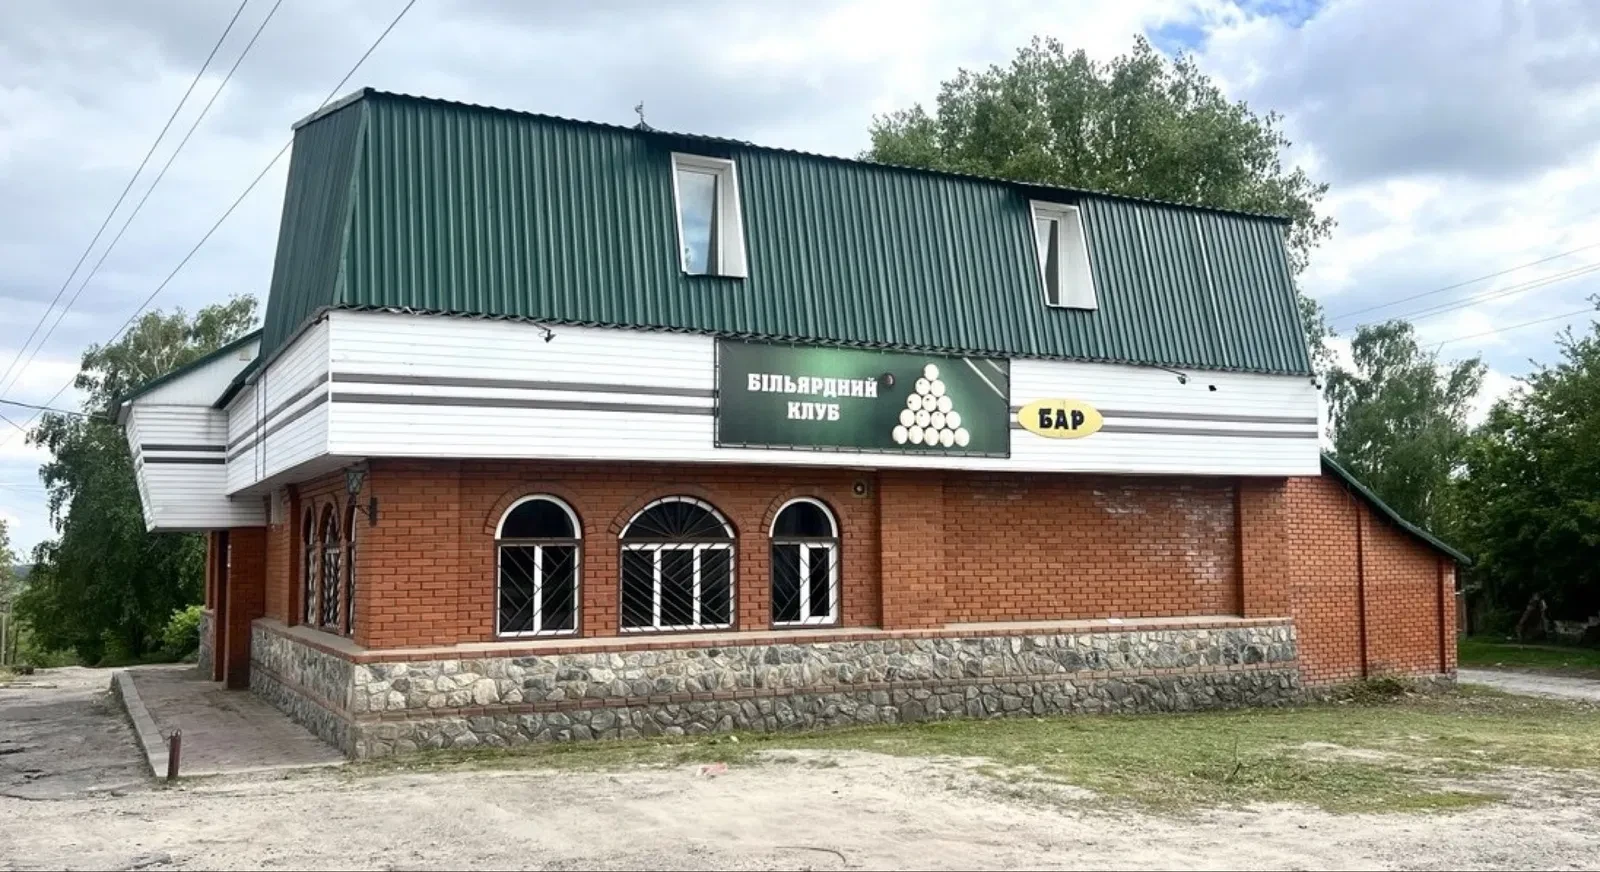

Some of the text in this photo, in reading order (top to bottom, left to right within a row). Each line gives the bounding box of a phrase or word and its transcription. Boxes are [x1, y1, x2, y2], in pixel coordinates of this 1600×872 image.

[747, 373, 878, 398] БІЛЬЯРДНИЙ
[787, 401, 840, 421] КЛУБ
[1038, 408, 1085, 431] БАР
